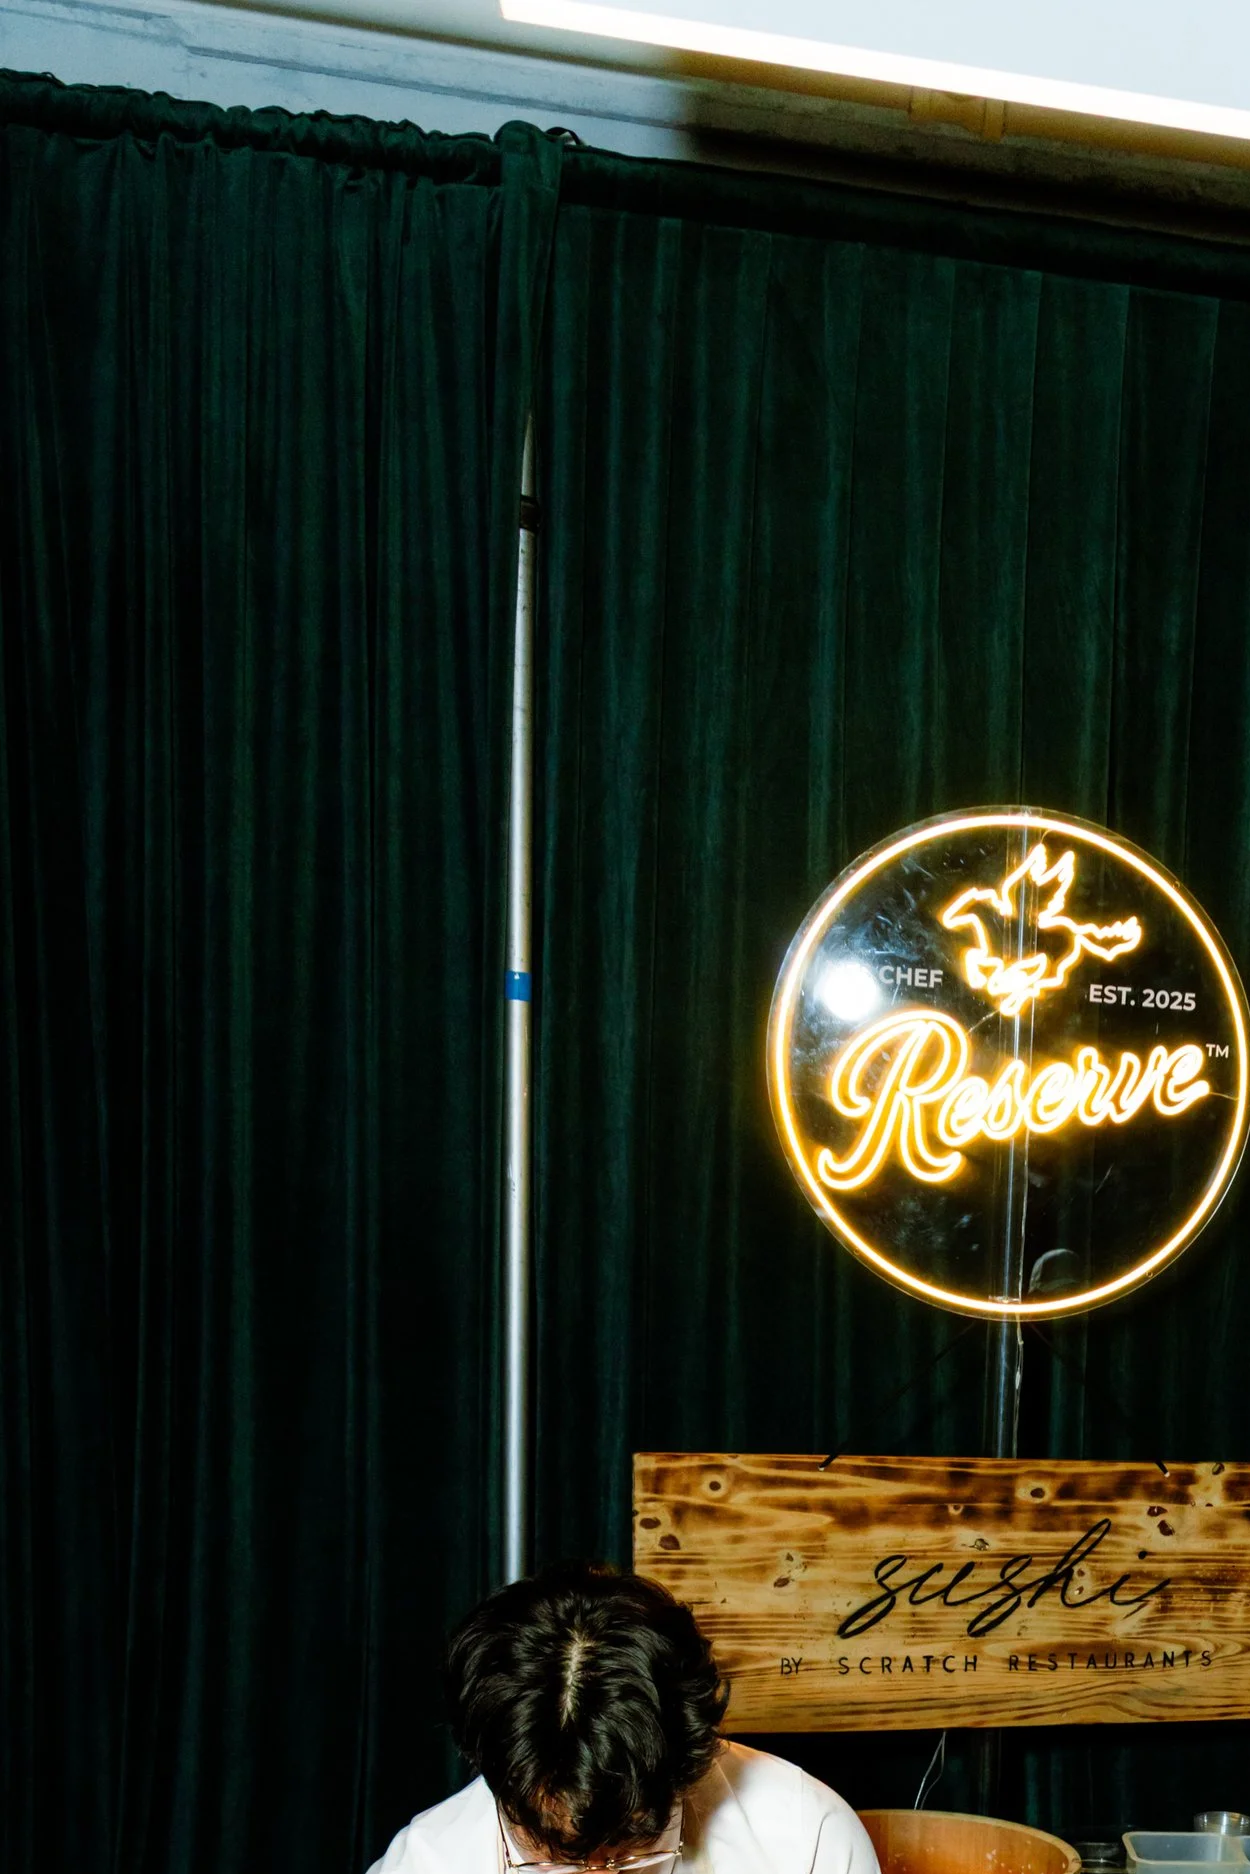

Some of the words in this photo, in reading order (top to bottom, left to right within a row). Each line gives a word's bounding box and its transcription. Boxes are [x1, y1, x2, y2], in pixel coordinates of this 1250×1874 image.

[878, 965, 944, 988] CHEF
[1089, 983, 1136, 1006] EST.
[1142, 988, 1196, 1011] 2025
[817, 1009, 1211, 1191] Reserve
[836, 1517, 1172, 1639] sushi
[780, 1657, 803, 1676] BY
[838, 1654, 979, 1675] SCRATCH
[1008, 1650, 1213, 1672] RESTAURANTS
